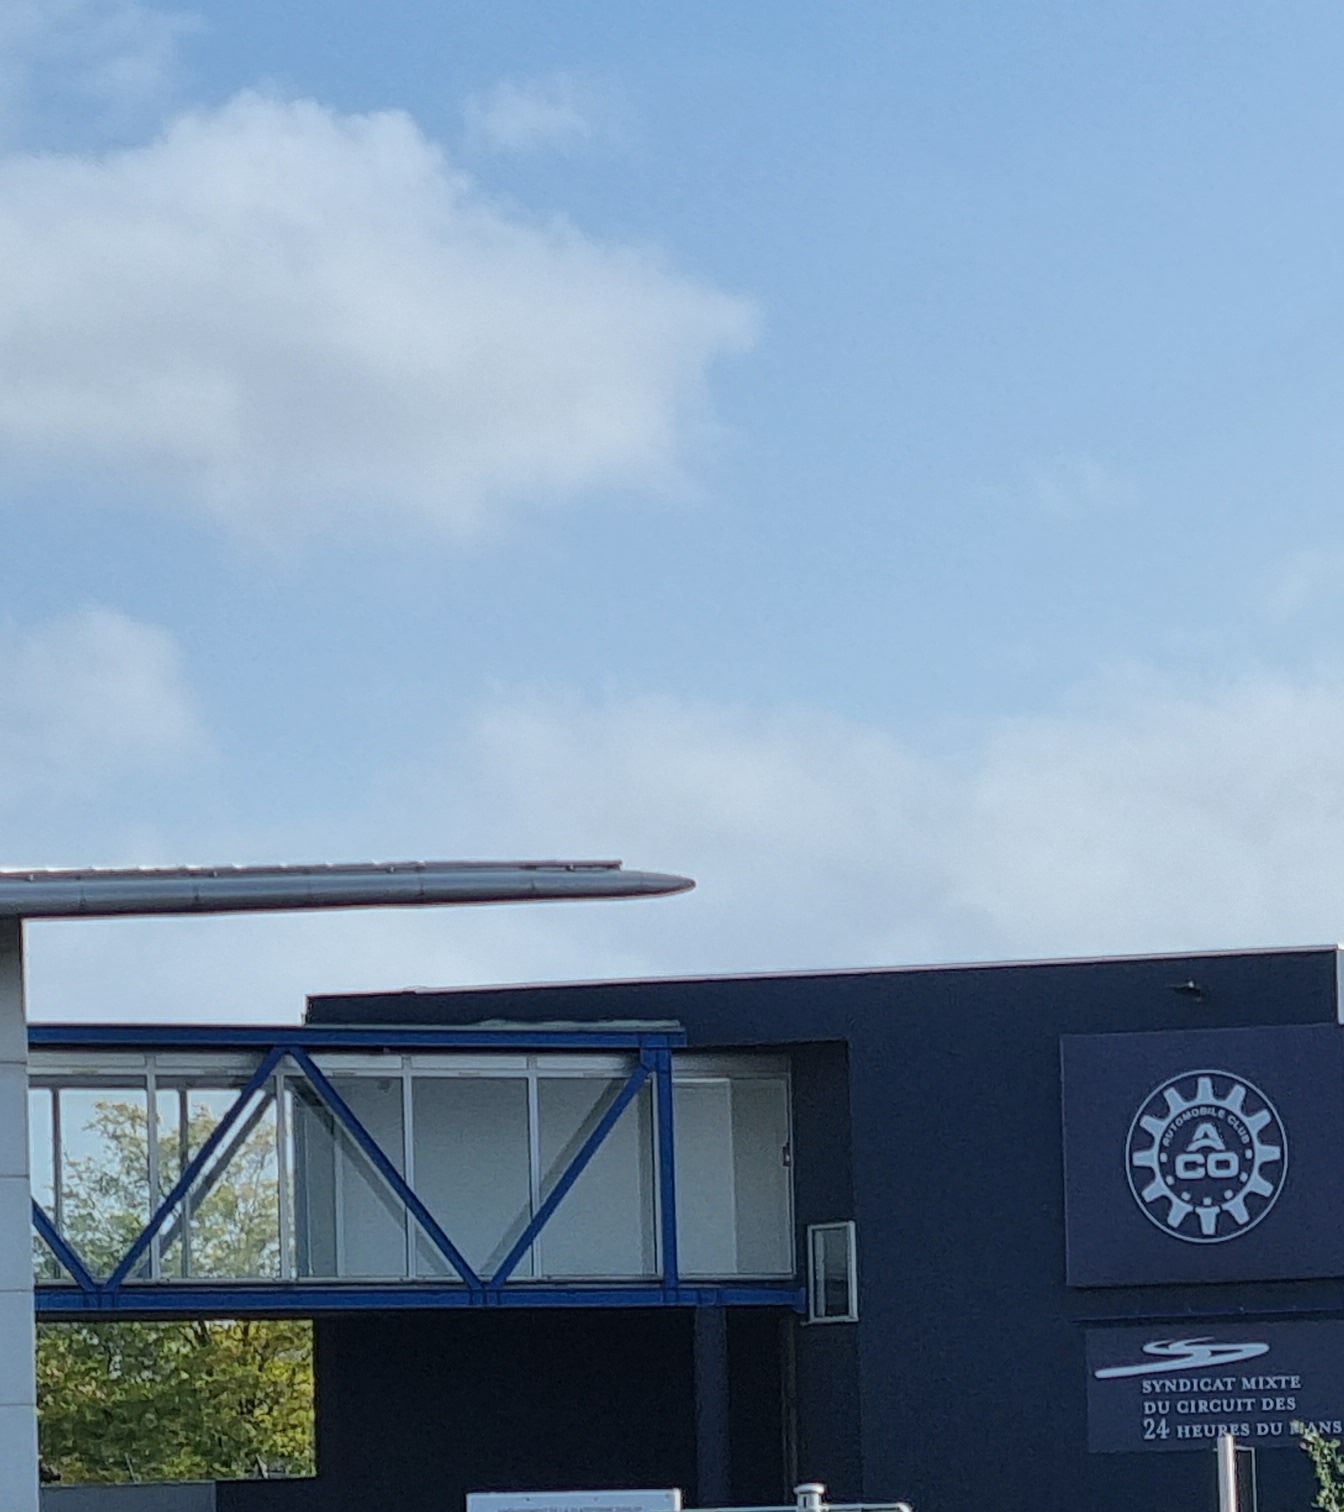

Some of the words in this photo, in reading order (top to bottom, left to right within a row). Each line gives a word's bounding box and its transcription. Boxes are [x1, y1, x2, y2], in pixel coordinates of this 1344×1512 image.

[1162, 1106, 1226, 1148] AUTOMOBILE
[1226, 1114, 1251, 1145] CLUB
[1142, 1377, 1236, 1394] SYNDICAT
[1241, 1375, 1301, 1390] MIXTE
[1143, 1401, 1170, 1415] DU
[1176, 1398, 1256, 1414] CIRCUIT
[1261, 1396, 1297, 1411] DES
[1142, 1418, 1170, 1440] 24
[1176, 1423, 1251, 1439] HEURES
[1256, 1422, 1283, 1436] DU
